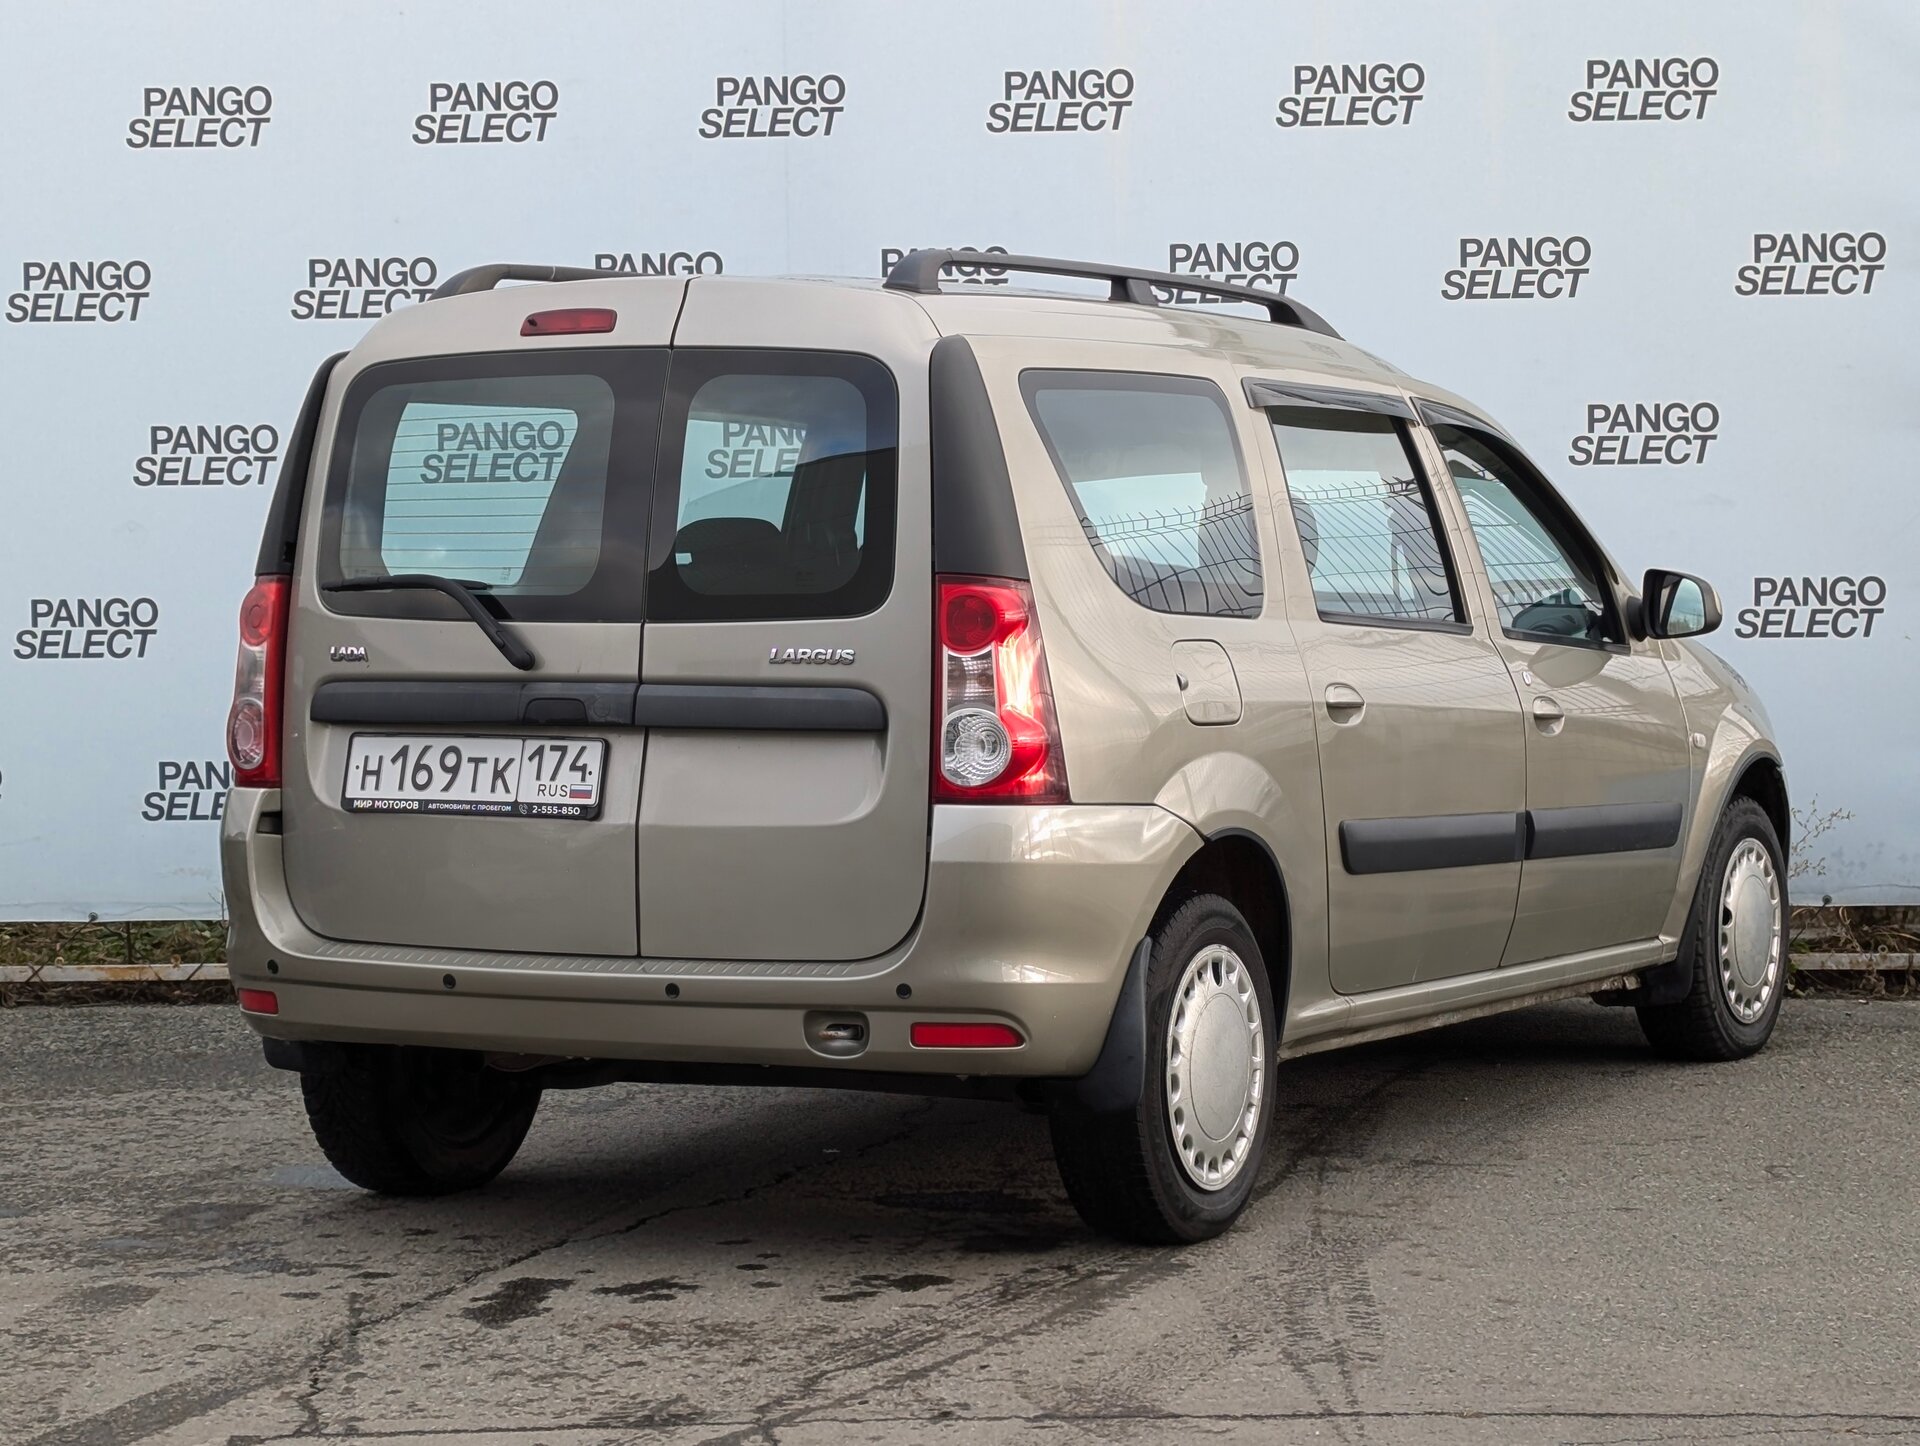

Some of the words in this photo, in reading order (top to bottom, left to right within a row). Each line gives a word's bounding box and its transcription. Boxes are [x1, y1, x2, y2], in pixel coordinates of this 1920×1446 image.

[1004, 69, 1133, 100] PANGO
[1294, 63, 1424, 94] PANGO
[1587, 58, 1718, 89] PANGO
[144, 86, 272, 116] PANGO
[430, 81, 559, 112] PANGO
[716, 75, 845, 106] PANGO
[1568, 90, 1718, 121] SELECT
[698, 107, 845, 138] SELECT
[987, 101, 1133, 132] SELECT
[1276, 95, 1424, 127] SELECT
[126, 118, 271, 148] SELECT
[412, 113, 558, 144] SELECT
[594, 251, 723, 276] PANGO
[1169, 241, 1299, 272] PANGO
[1460, 236, 1591, 268] PANGO
[1754, 233, 1886, 264] PANGO
[24, 261, 151, 291] PANGO
[308, 257, 437, 287] PANGO
[1441, 269, 1590, 300] SELECT
[1735, 265, 1885, 295] SELECT
[6, 292, 150, 322] SELECT
[1588, 403, 1719, 433] PANGO
[150, 425, 279, 454] PANGO
[437, 421, 565, 451] PANGO
[722, 420, 805, 447] PAN
[704, 448, 799, 478] SELE
[1569, 434, 1718, 465] SELECT
[133, 456, 278, 486] SELECT
[420, 452, 564, 483] SELECT
[1754, 576, 1887, 607] PANGO
[31, 598, 159, 628] PANGO
[1735, 608, 1885, 638] SELECT
[14, 629, 157, 659] SELECT
[330, 646, 368, 662] LADA
[768, 647, 856, 665] LARGUS
[159, 761, 235, 790] PAN
[360, 744, 516, 794] Н169ТК
[527, 744, 588, 782] 174
[353, 800, 373, 809] МИР
[374, 801, 419, 810] МОТОРОВ
[537, 784, 568, 798] RUS
[142, 792, 226, 821] SELE
[427, 803, 471, 811] АВТОМОБИЛИ
[477, 804, 512, 812] ПРОБЕГОМ
[532, 805, 581, 815] 2-555-850
